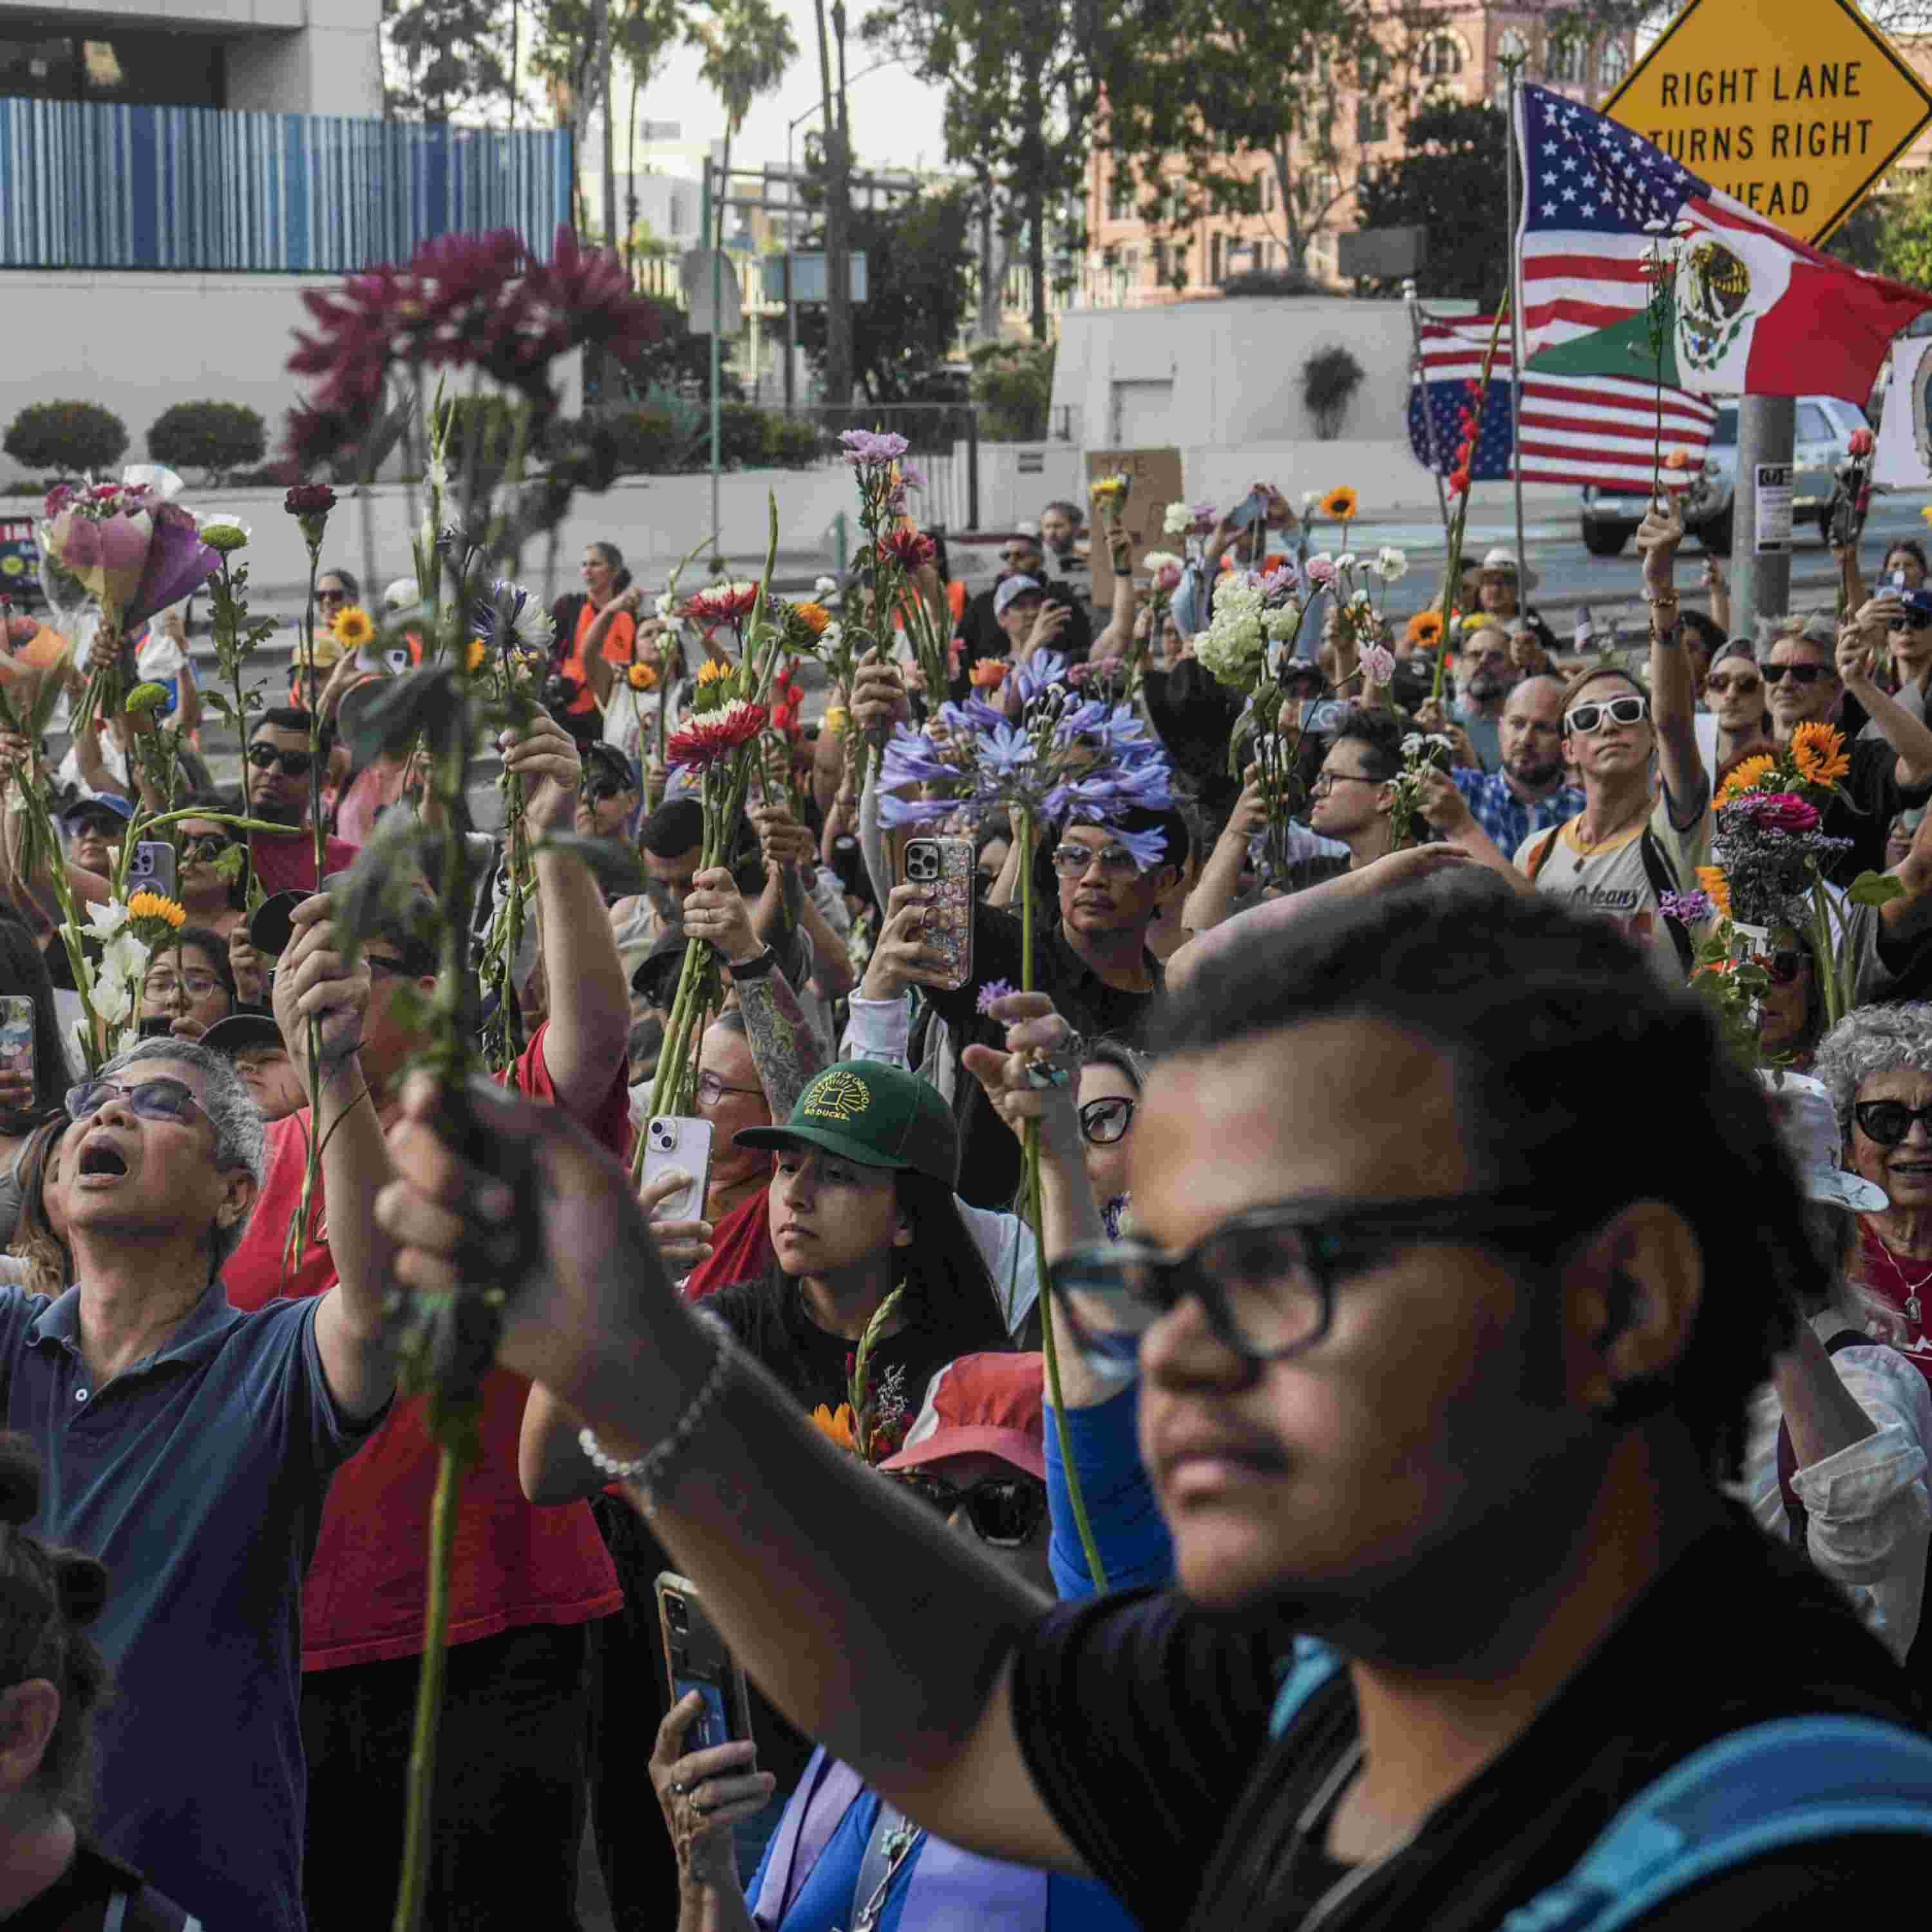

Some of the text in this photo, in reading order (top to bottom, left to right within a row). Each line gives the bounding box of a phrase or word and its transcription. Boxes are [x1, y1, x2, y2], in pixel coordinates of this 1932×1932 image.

[1662, 62, 1861, 108] RIGHT LANE
[1648, 120, 1873, 162] TURNS RIGHT
